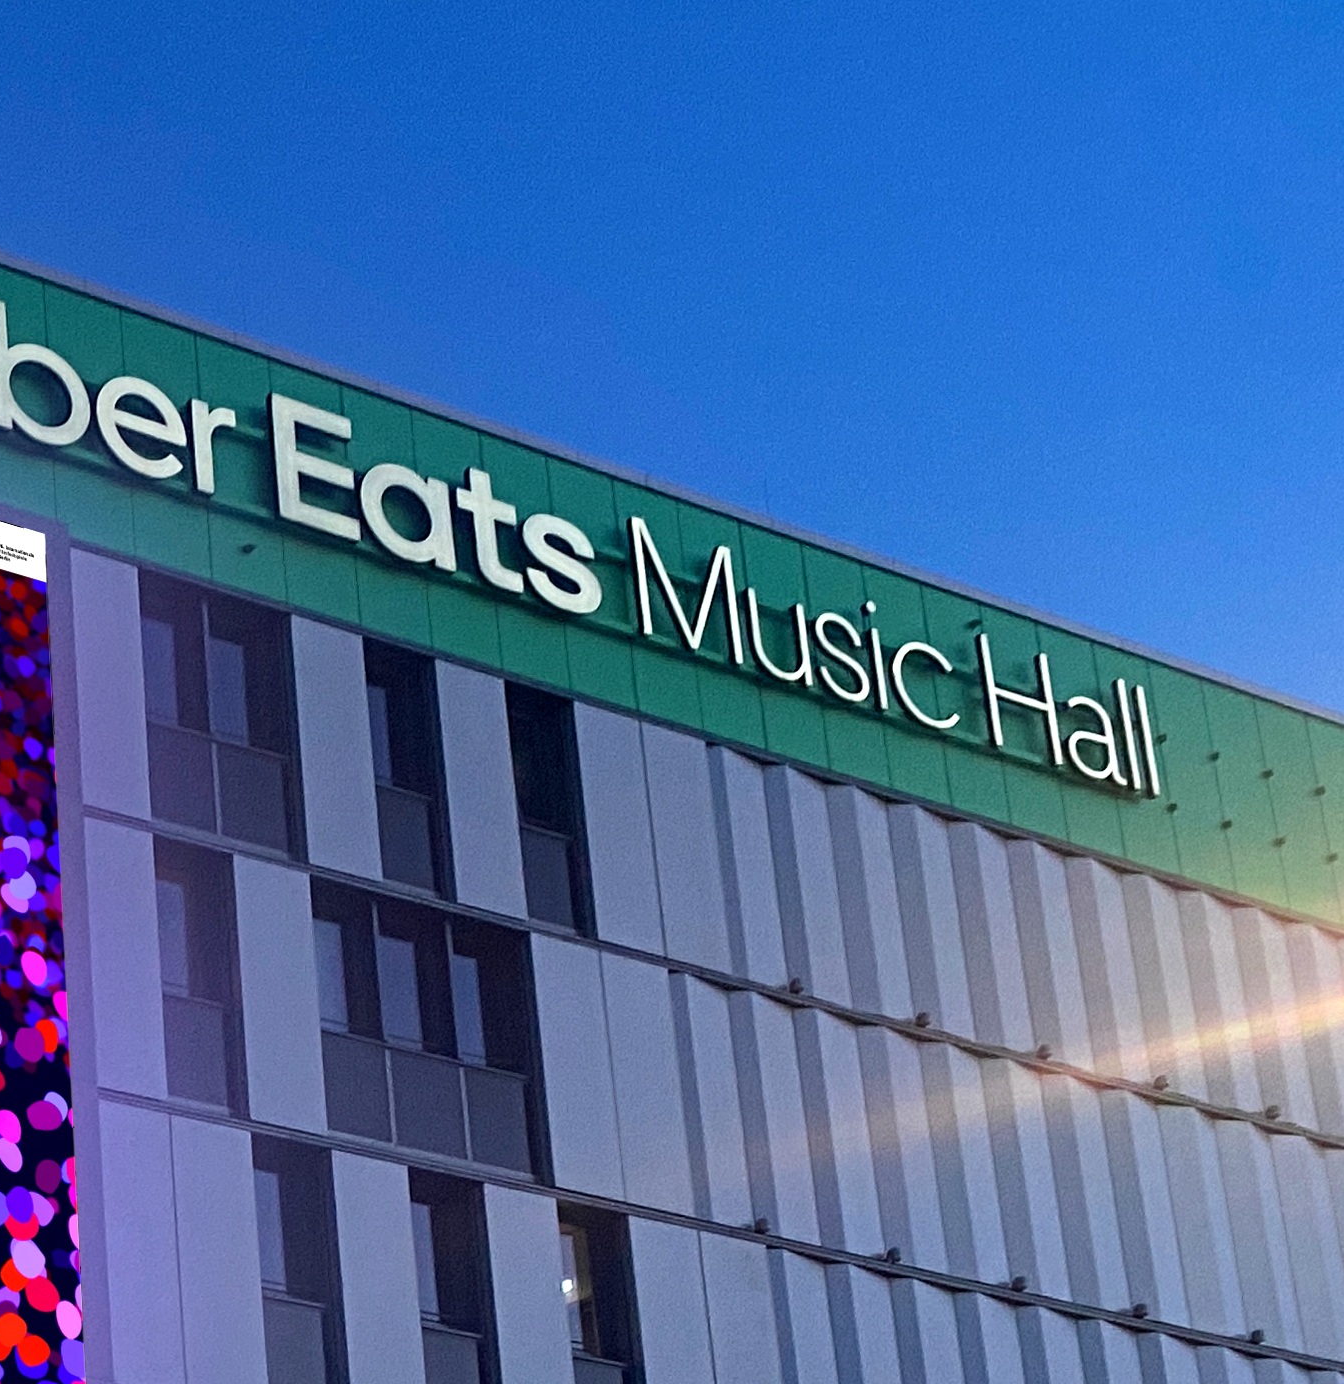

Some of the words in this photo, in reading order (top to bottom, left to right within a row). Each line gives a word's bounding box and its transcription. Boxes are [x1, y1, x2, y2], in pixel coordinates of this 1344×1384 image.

[269, 393, 602, 613] Eats
[629, 516, 960, 729] Music
[978, 633, 1160, 798] Hall
